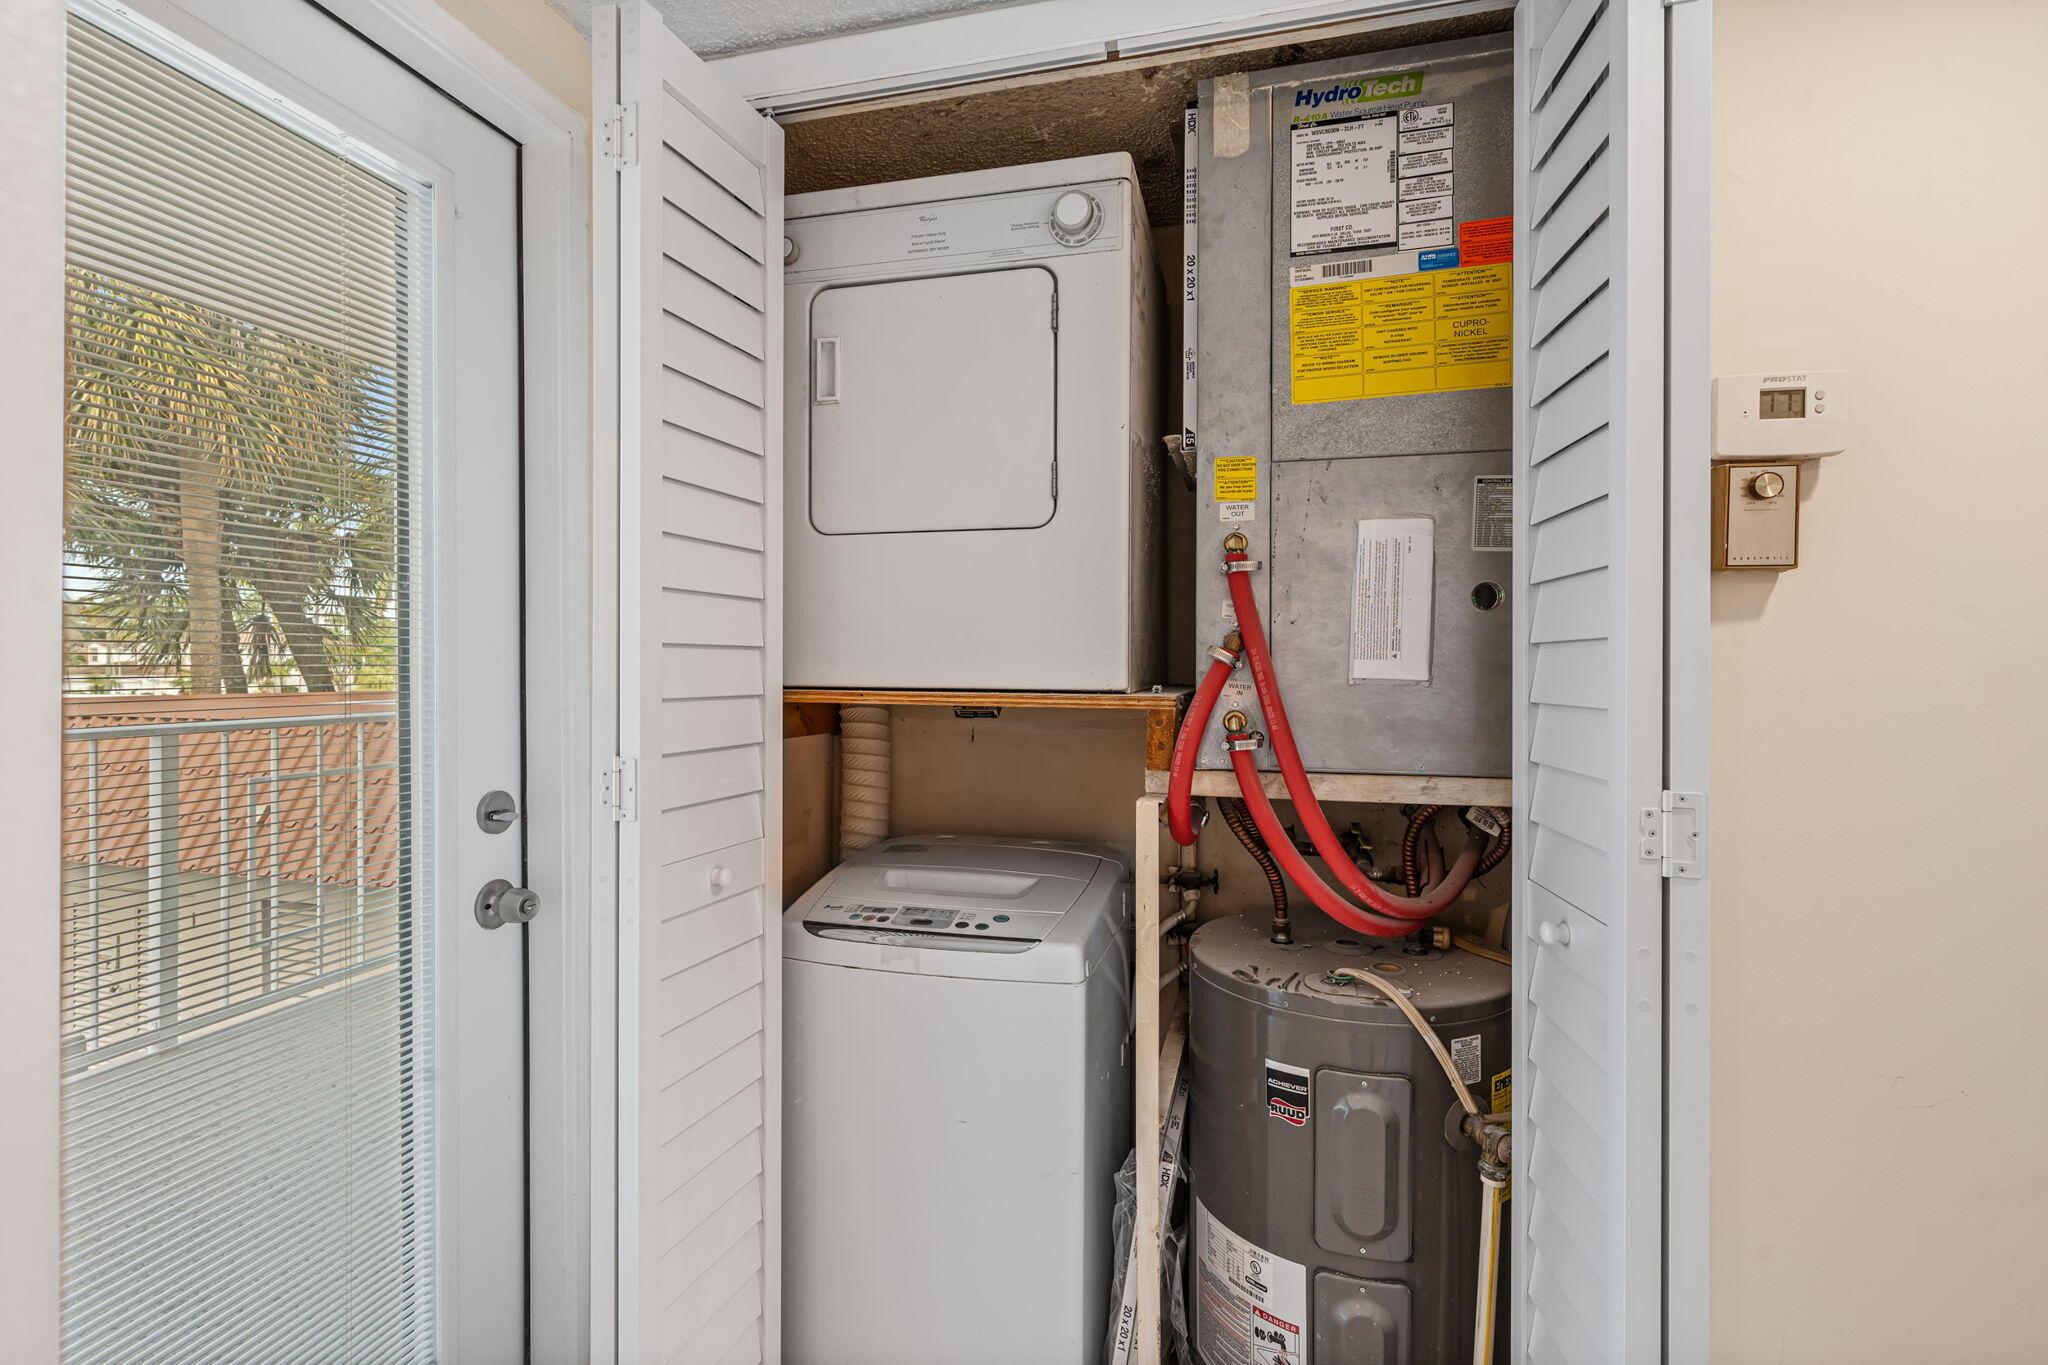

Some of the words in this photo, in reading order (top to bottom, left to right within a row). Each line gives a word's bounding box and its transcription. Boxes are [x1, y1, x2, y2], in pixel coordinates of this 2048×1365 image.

[1330, 109, 1353, 119] Water
[1354, 106, 1384, 117] Source
[1384, 103, 1403, 112] Heat
[1404, 99, 1428, 110] Pump
[1187, 113, 1197, 135] HDX
[1186, 255, 1196, 267] 20
[1186, 277, 1196, 288] 20
[1452, 318, 1490, 328] CUPRO-
[1453, 328, 1488, 338] NICKEL
[1762, 374, 1807, 384] PROSTAT
[1268, 1078, 1307, 1092] ACHIEVER
[1270, 1104, 1306, 1120] RUUD
[1160, 1167, 1171, 1189] HDX
[1124, 1305, 1132, 1318] 20
[1262, 1312, 1298, 1333] DANGER
[1120, 1326, 1129, 1339] 20
